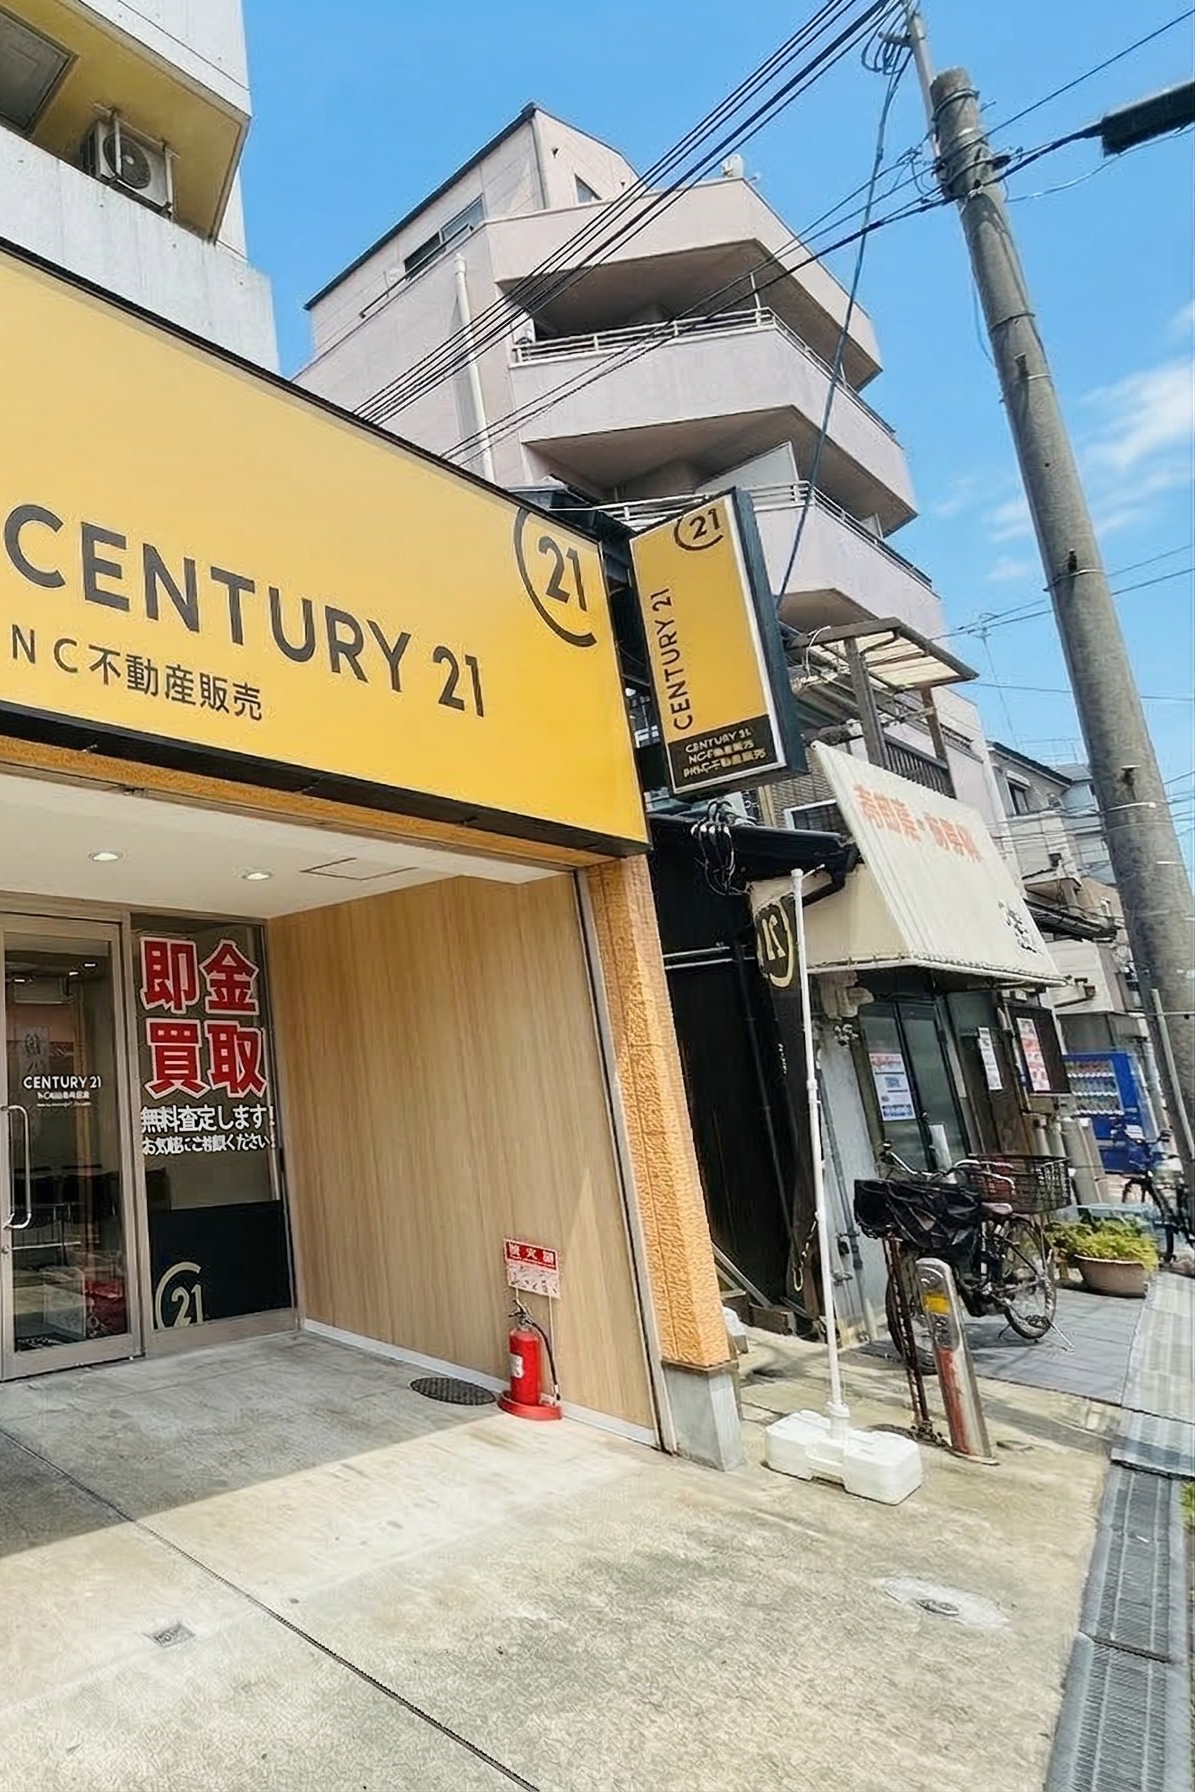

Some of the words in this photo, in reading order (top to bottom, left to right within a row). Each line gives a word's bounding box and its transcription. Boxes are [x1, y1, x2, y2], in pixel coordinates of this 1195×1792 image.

[4, 504, 412, 694] CENTURY
[432, 645, 486, 718] 21
[650, 588, 673, 612] 21
[654, 618, 694, 731] CENTURY
[139, 936, 261, 1016] 即金
[23, 1074, 88, 1089] CENTURY
[90, 1074, 102, 1089] 21
[143, 1017, 269, 1101] 買取
